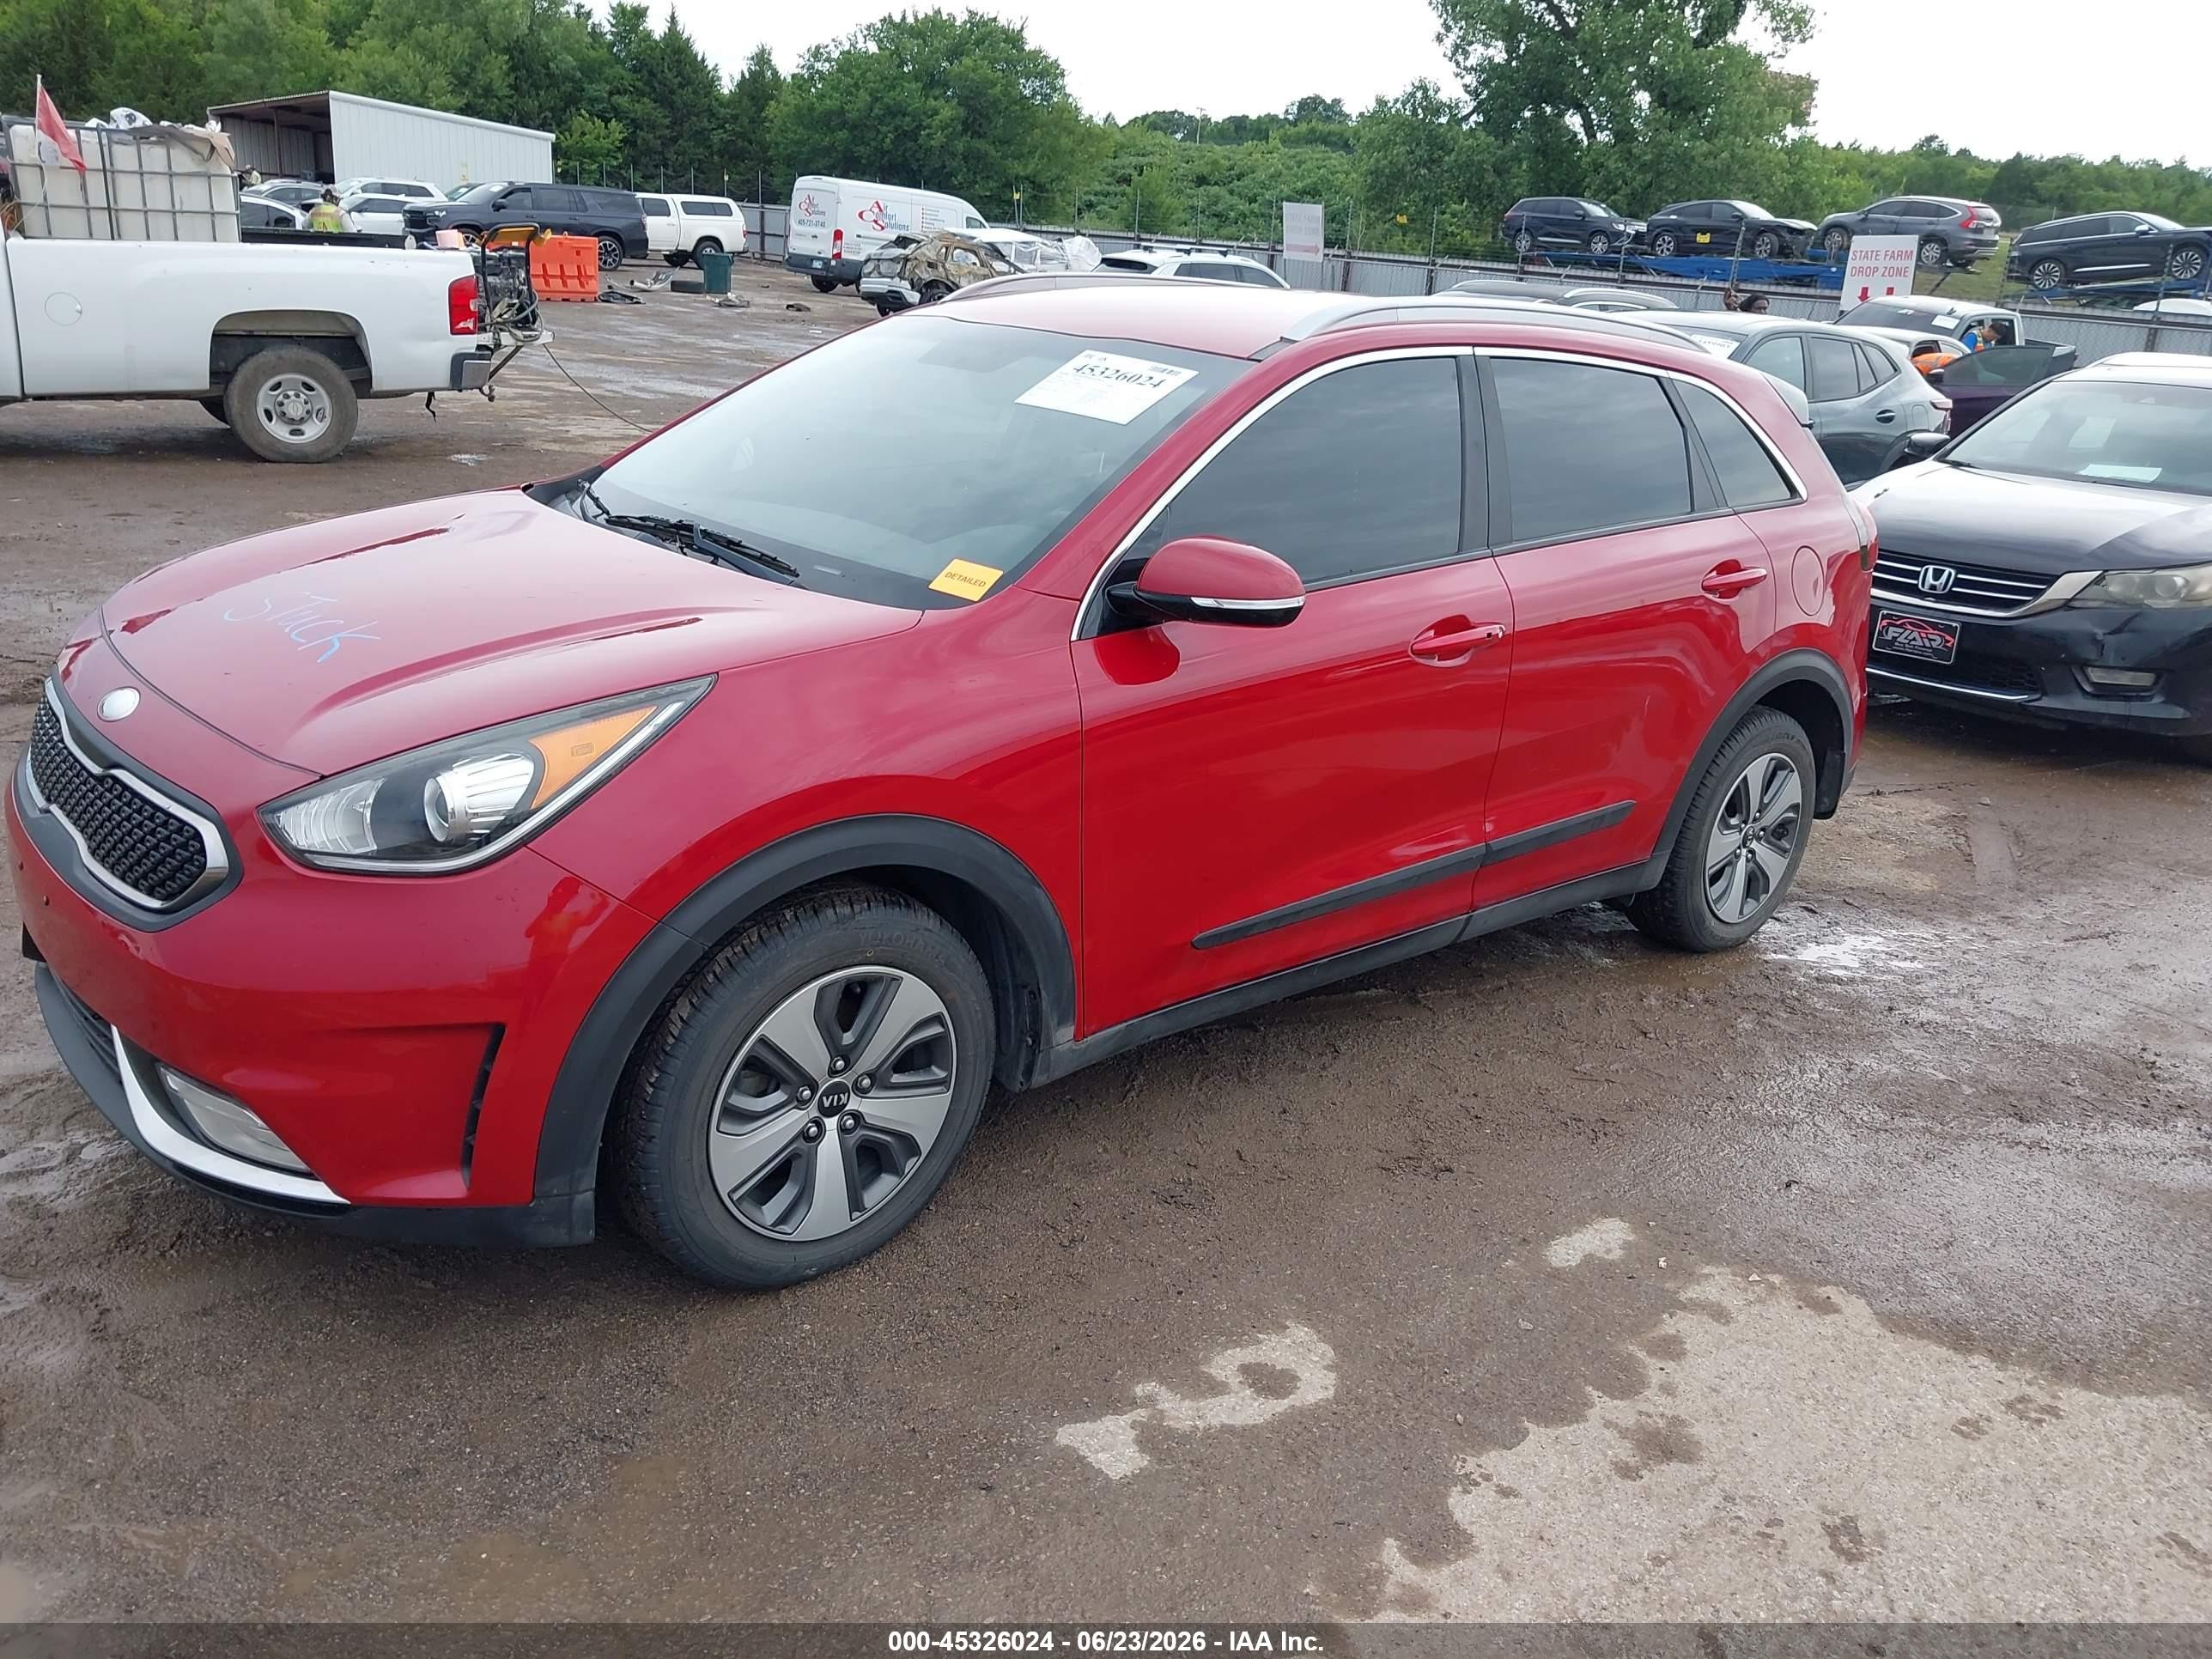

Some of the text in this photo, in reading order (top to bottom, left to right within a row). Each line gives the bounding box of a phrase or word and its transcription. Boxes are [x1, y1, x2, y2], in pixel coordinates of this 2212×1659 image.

[1851, 250, 1914, 261] STATE FARM
[1850, 266, 1910, 277] DROP ZONE
[1073, 362, 1167, 388] 45326024
[944, 571, 987, 587] DETAILED
[822, 1091, 849, 1108] KIA
